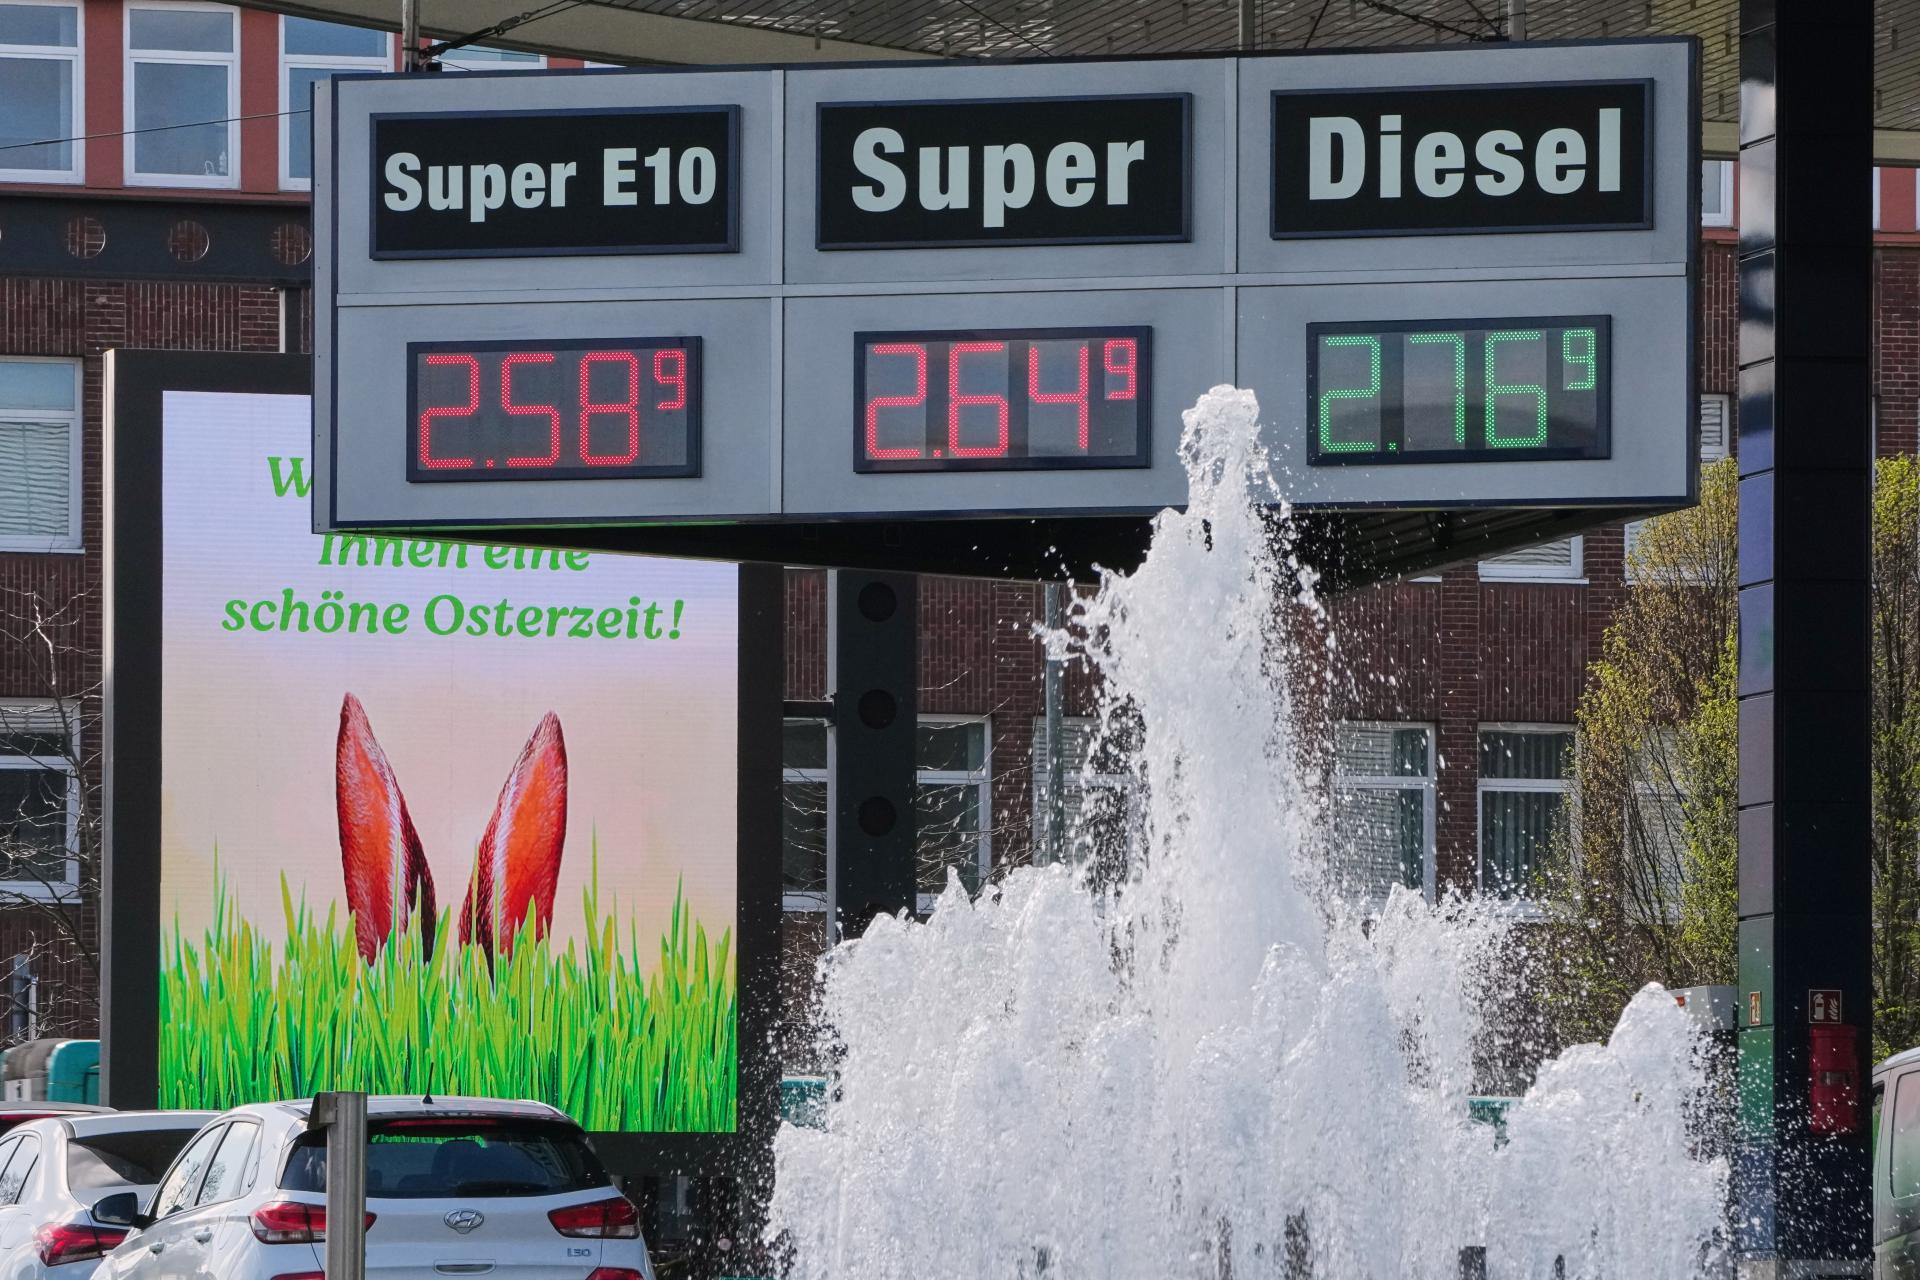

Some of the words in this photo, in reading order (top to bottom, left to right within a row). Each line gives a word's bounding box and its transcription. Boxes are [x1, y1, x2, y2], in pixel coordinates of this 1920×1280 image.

[383, 152, 577, 223] Super
[603, 146, 717, 206] E10
[851, 127, 1145, 228] Super
[1309, 107, 1622, 200] Diesel
[222, 588, 410, 634] schöne
[424, 594, 685, 640] Osterzeit!
